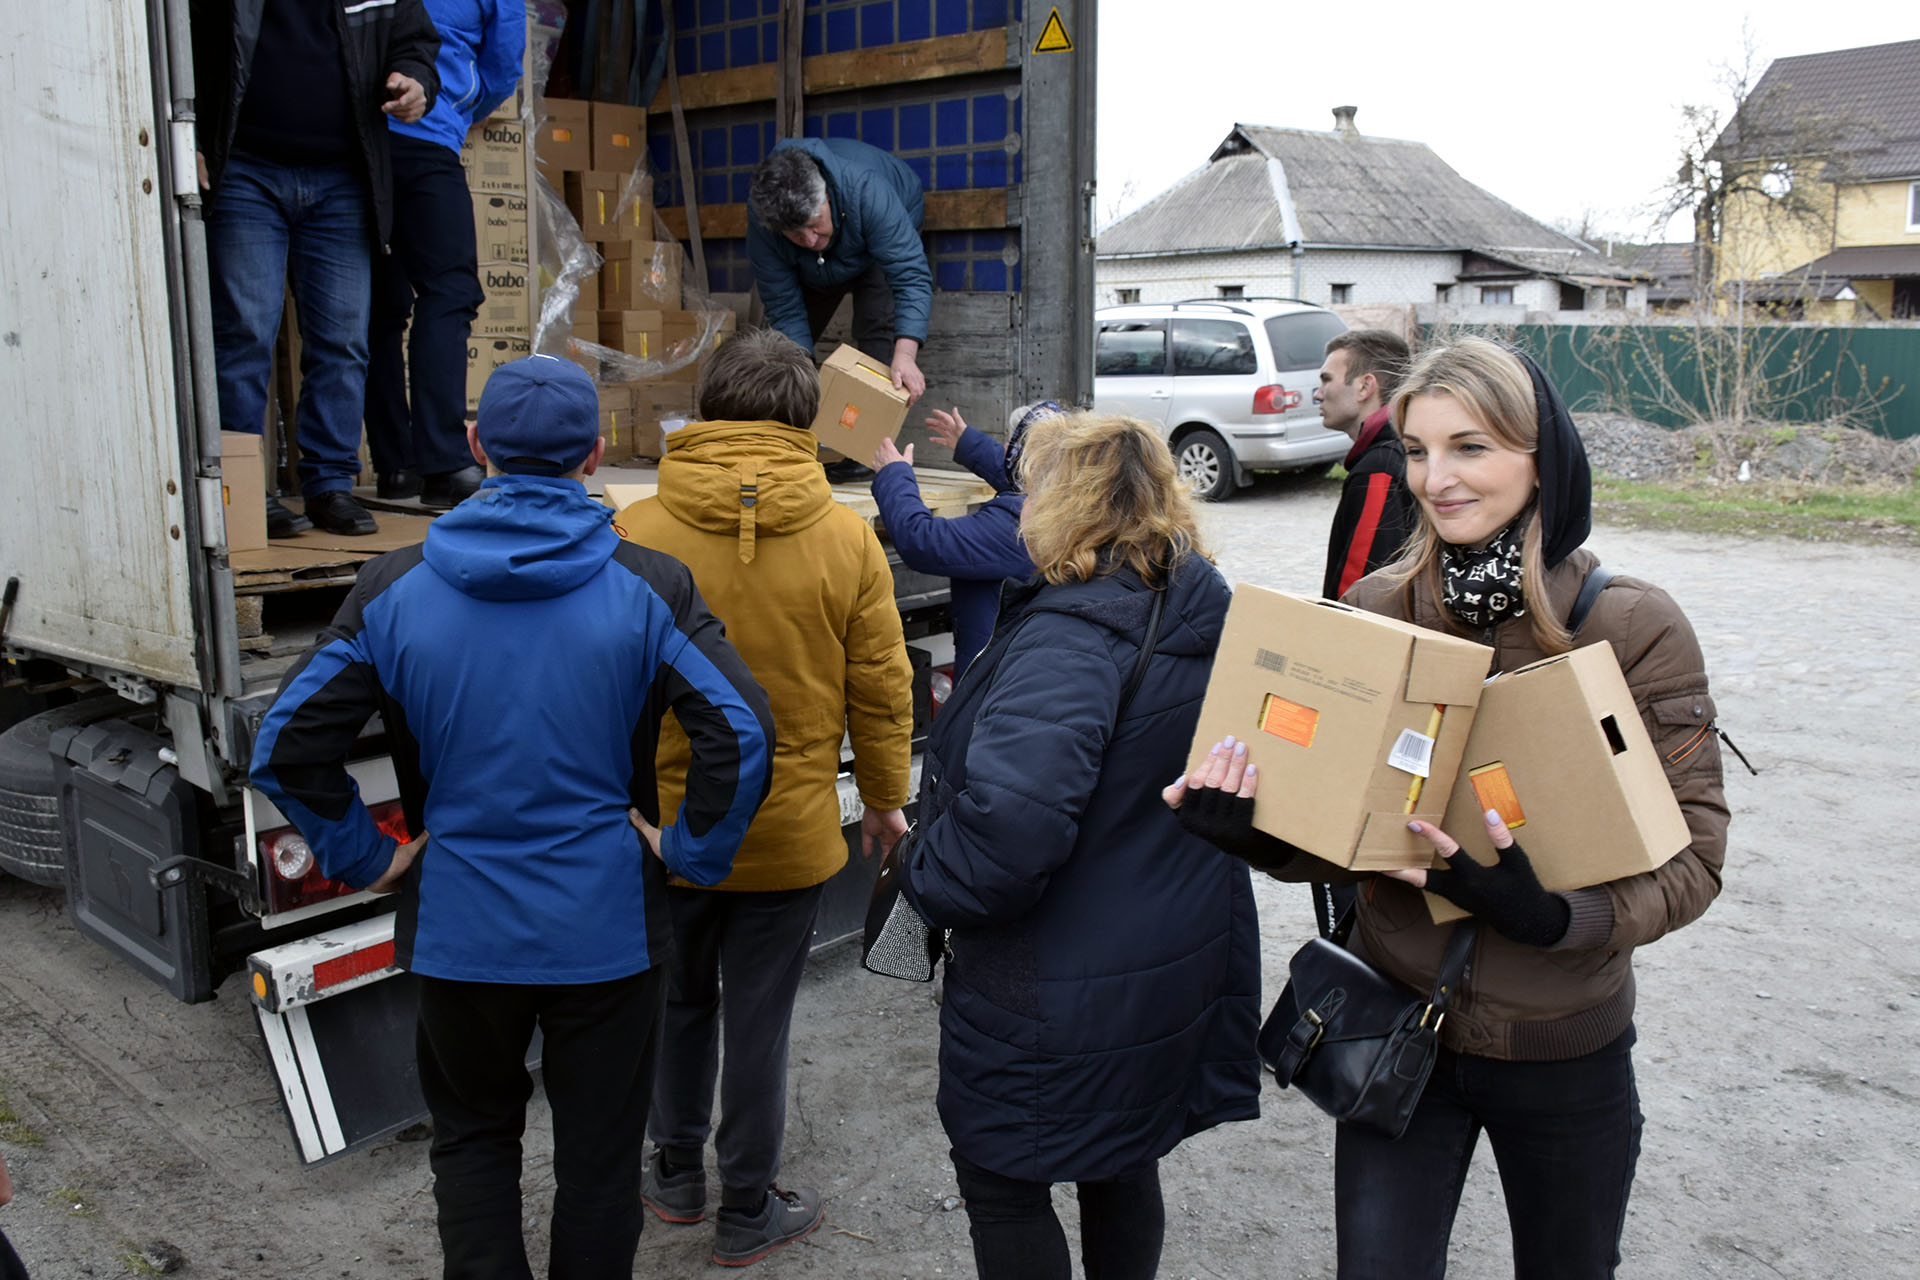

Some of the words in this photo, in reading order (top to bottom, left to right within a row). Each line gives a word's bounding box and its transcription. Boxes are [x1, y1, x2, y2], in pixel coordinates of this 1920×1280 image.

[483, 125, 522, 144] baba
[508, 199, 527, 210] bab
[487, 217, 508, 226] baba
[486, 270, 525, 288] baba
[511, 340, 530, 352] bab
